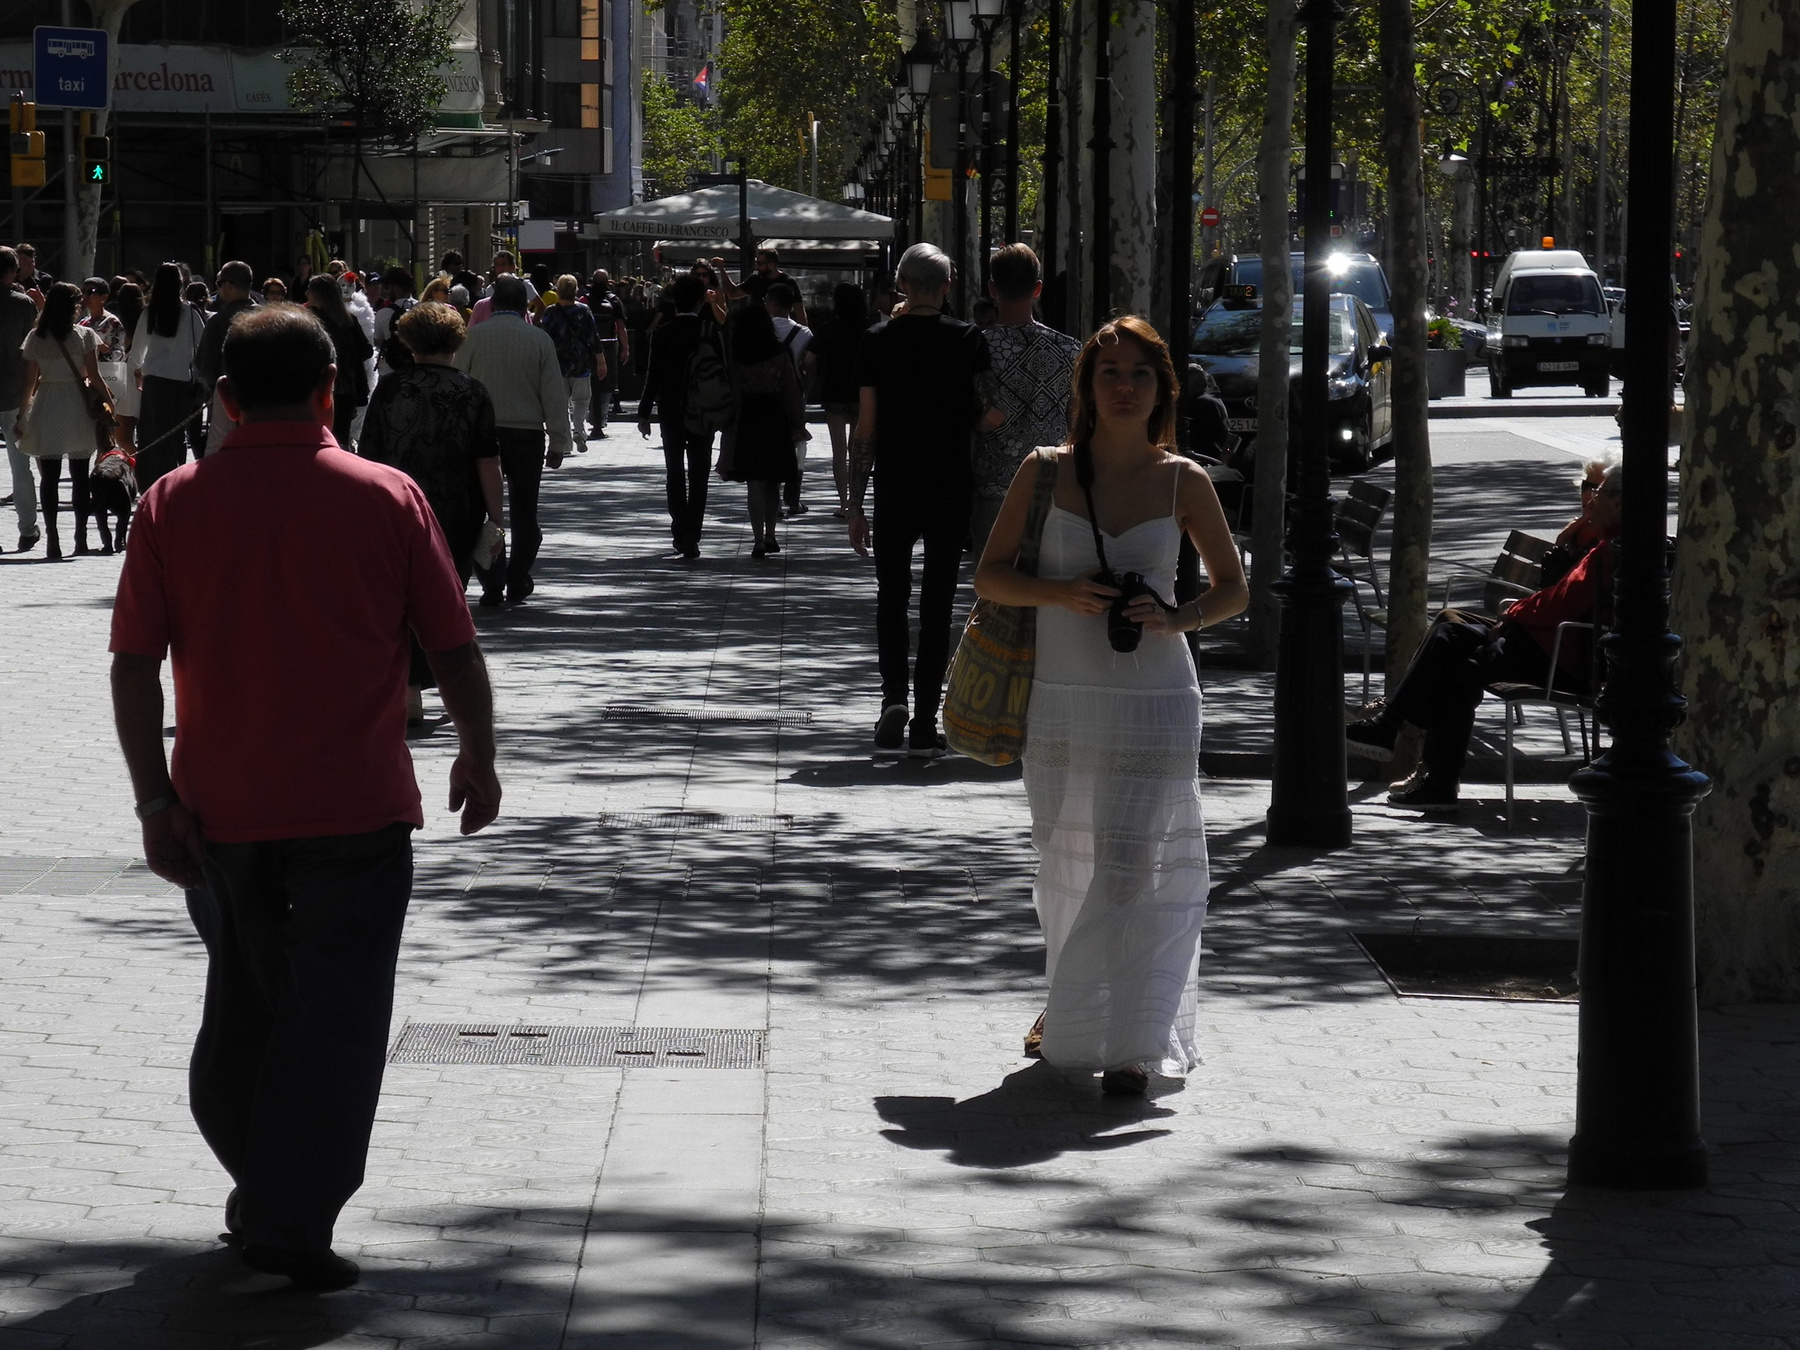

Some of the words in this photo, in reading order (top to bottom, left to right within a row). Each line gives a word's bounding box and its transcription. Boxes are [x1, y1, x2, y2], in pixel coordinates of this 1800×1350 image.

[57, 76, 86, 92] taxi
[610, 219, 621, 232] IL
[657, 223, 668, 235] DI
[670, 224, 729, 238] FRANCESCO
